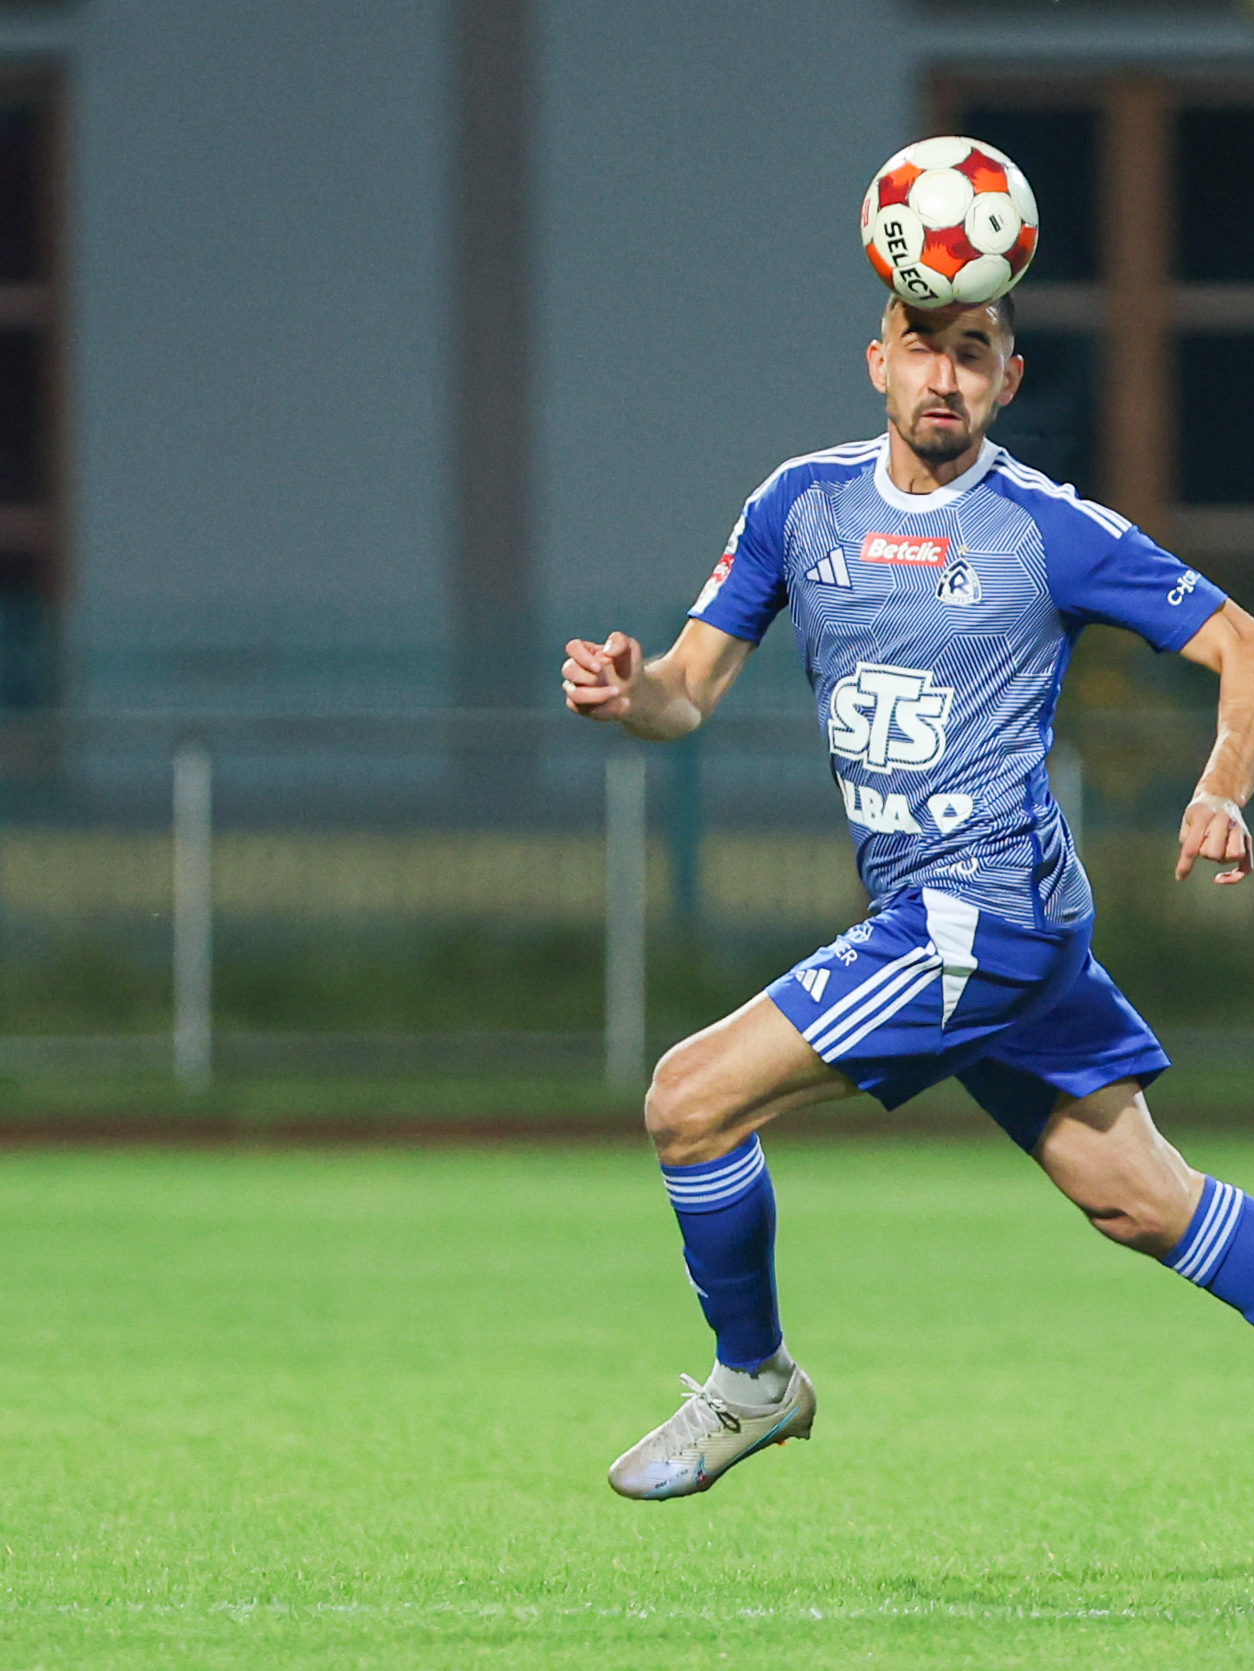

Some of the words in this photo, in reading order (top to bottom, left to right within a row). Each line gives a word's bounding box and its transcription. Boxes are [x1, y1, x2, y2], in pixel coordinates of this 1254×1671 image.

[884, 221, 939, 301] SELECT
[866, 538, 942, 562] Betclic
[828, 661, 955, 775] STS
